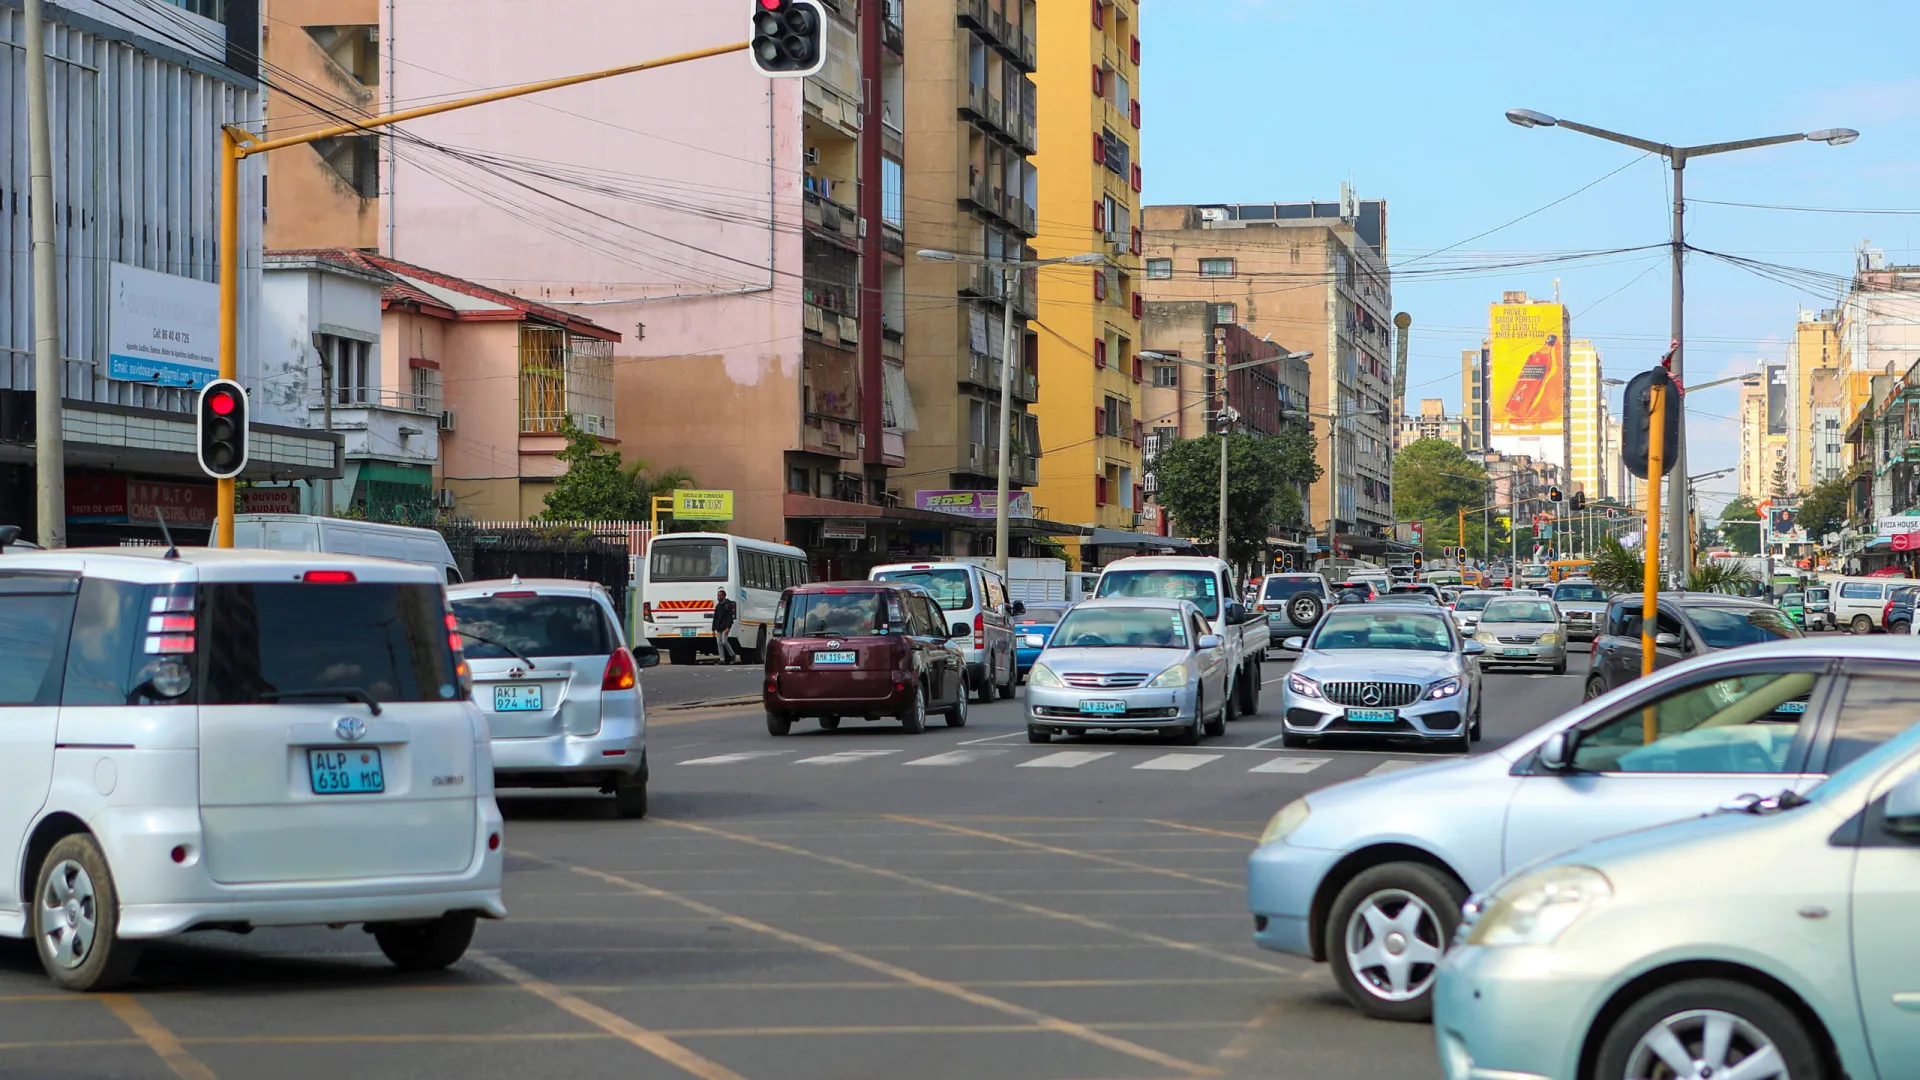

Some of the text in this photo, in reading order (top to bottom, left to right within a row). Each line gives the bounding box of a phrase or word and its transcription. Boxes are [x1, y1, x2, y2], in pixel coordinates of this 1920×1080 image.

[252, 493, 287, 501] OUVIDO
[684, 499, 723, 509] ELTON
[72, 505, 123, 514] TESTE DE VISTA
[497, 688, 517, 698] AKI
[497, 698, 540, 709] 974 MC
[1115, 702, 1125, 711] MC
[317, 753, 347, 769] ALP
[319, 772, 382, 789] 630 MC
